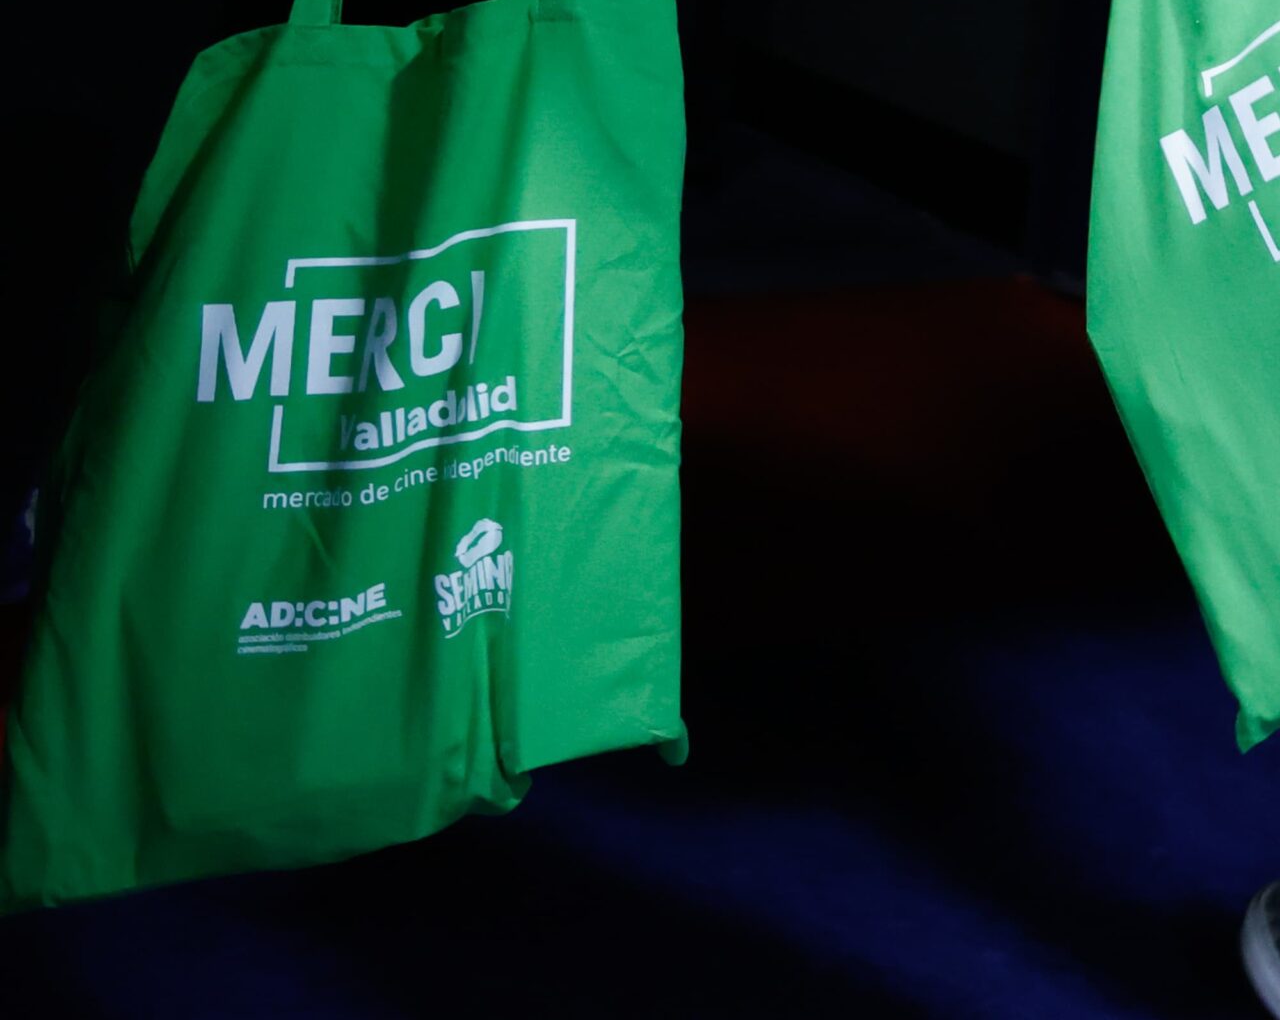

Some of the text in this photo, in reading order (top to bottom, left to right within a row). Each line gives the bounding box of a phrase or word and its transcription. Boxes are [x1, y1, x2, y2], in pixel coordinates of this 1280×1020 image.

[197, 270, 485, 402] MERCI
[263, 444, 571, 509] mercado de cine idependiente
